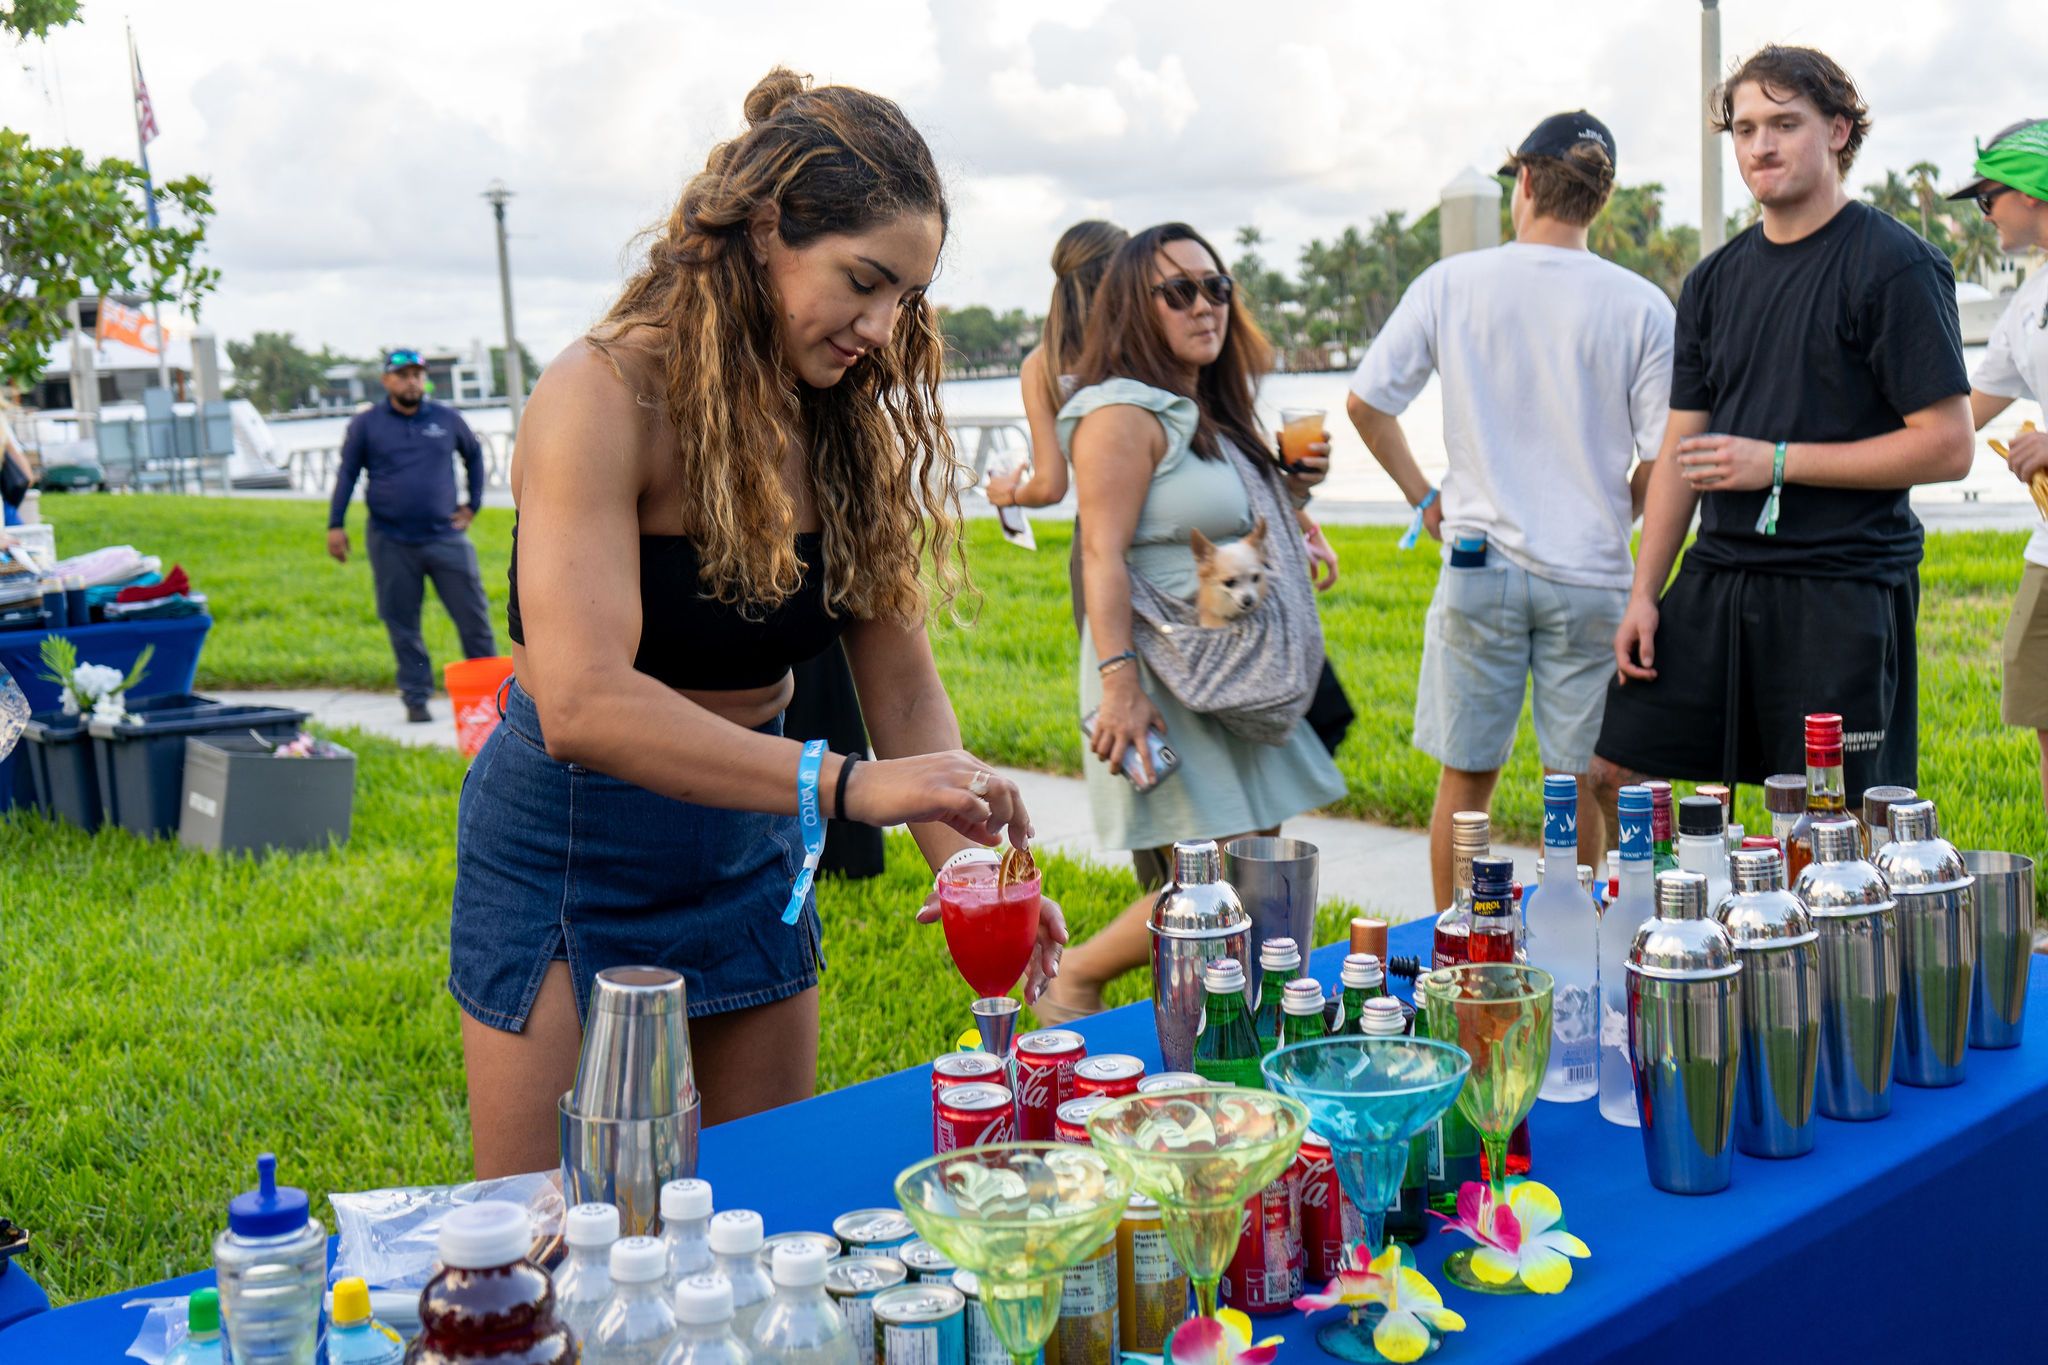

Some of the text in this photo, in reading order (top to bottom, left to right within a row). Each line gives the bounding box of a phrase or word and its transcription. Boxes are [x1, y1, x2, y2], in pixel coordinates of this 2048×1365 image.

[1842, 730, 1885, 743] SSENTIALS
[801, 785, 817, 827] YATCO
[1474, 900, 1501, 911] APEROL
